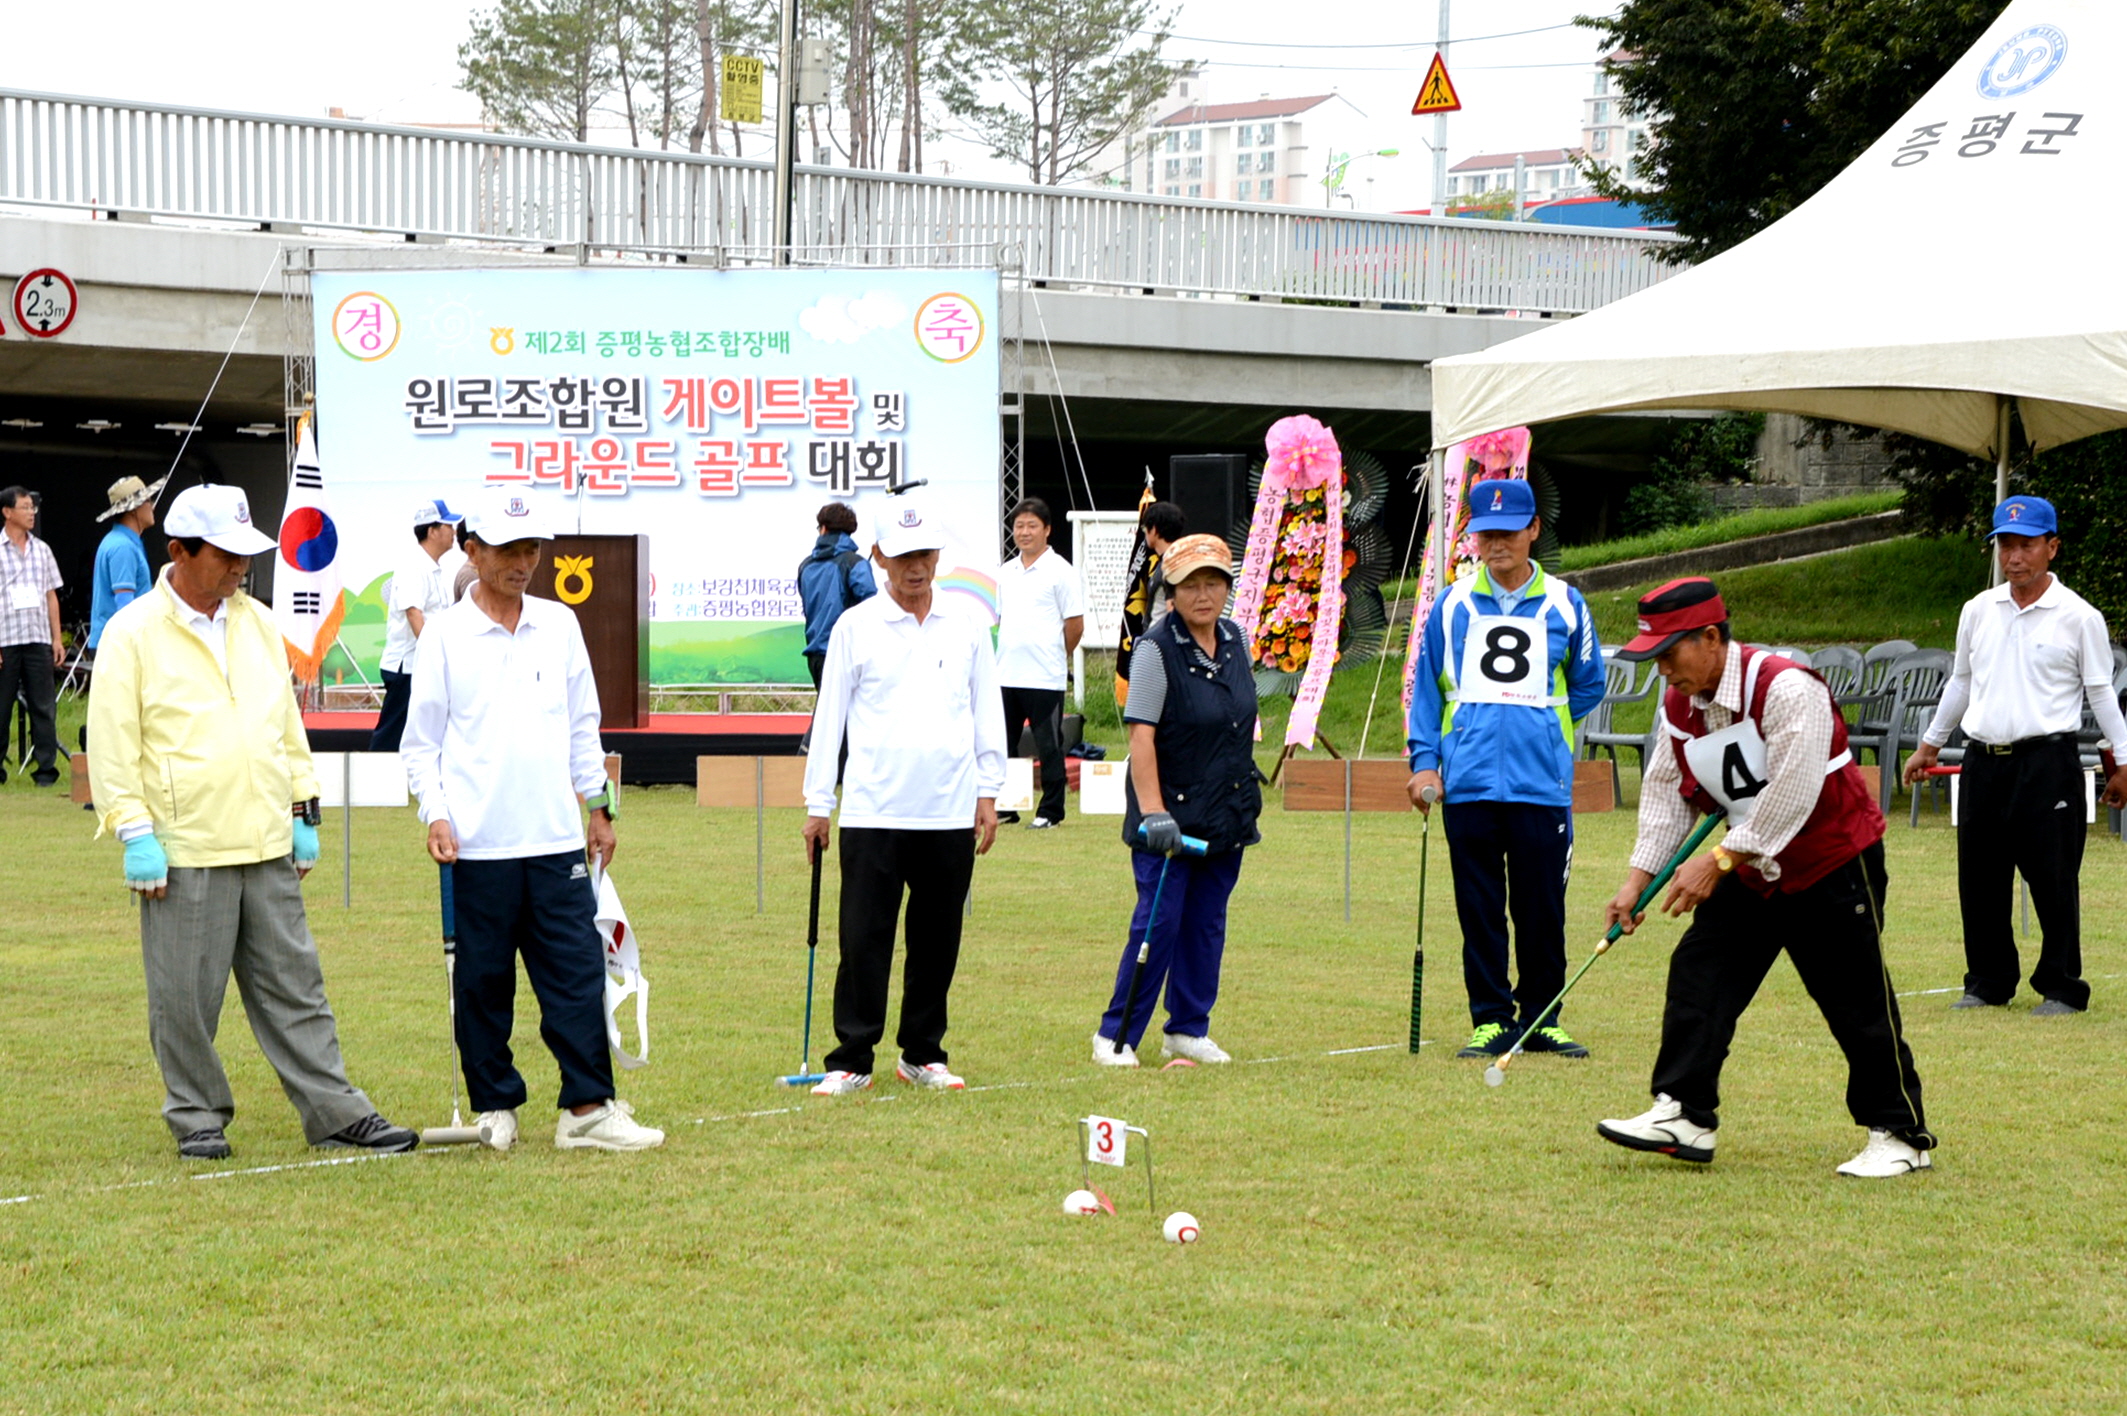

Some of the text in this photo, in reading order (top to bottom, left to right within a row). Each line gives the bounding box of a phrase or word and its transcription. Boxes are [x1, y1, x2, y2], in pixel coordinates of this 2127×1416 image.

[727, 59, 759, 74] CCTV
[1891, 111, 2084, 167] 증평군
[26, 289, 66, 317] 2.3m
[344, 302, 382, 351] 경
[925, 303, 974, 352] 축
[525, 330, 790, 357] 제2회 증평농협조합장배
[405, 377, 900, 429] 원로조합원 게이트볼 및
[485, 439, 898, 491] 그라운드 골프 대회
[703, 599, 806, 618] 증평농협원로
[1480, 625, 1532, 684] 8
[1722, 741, 1769, 802] 4
[1096, 1121, 1114, 1153] 3
